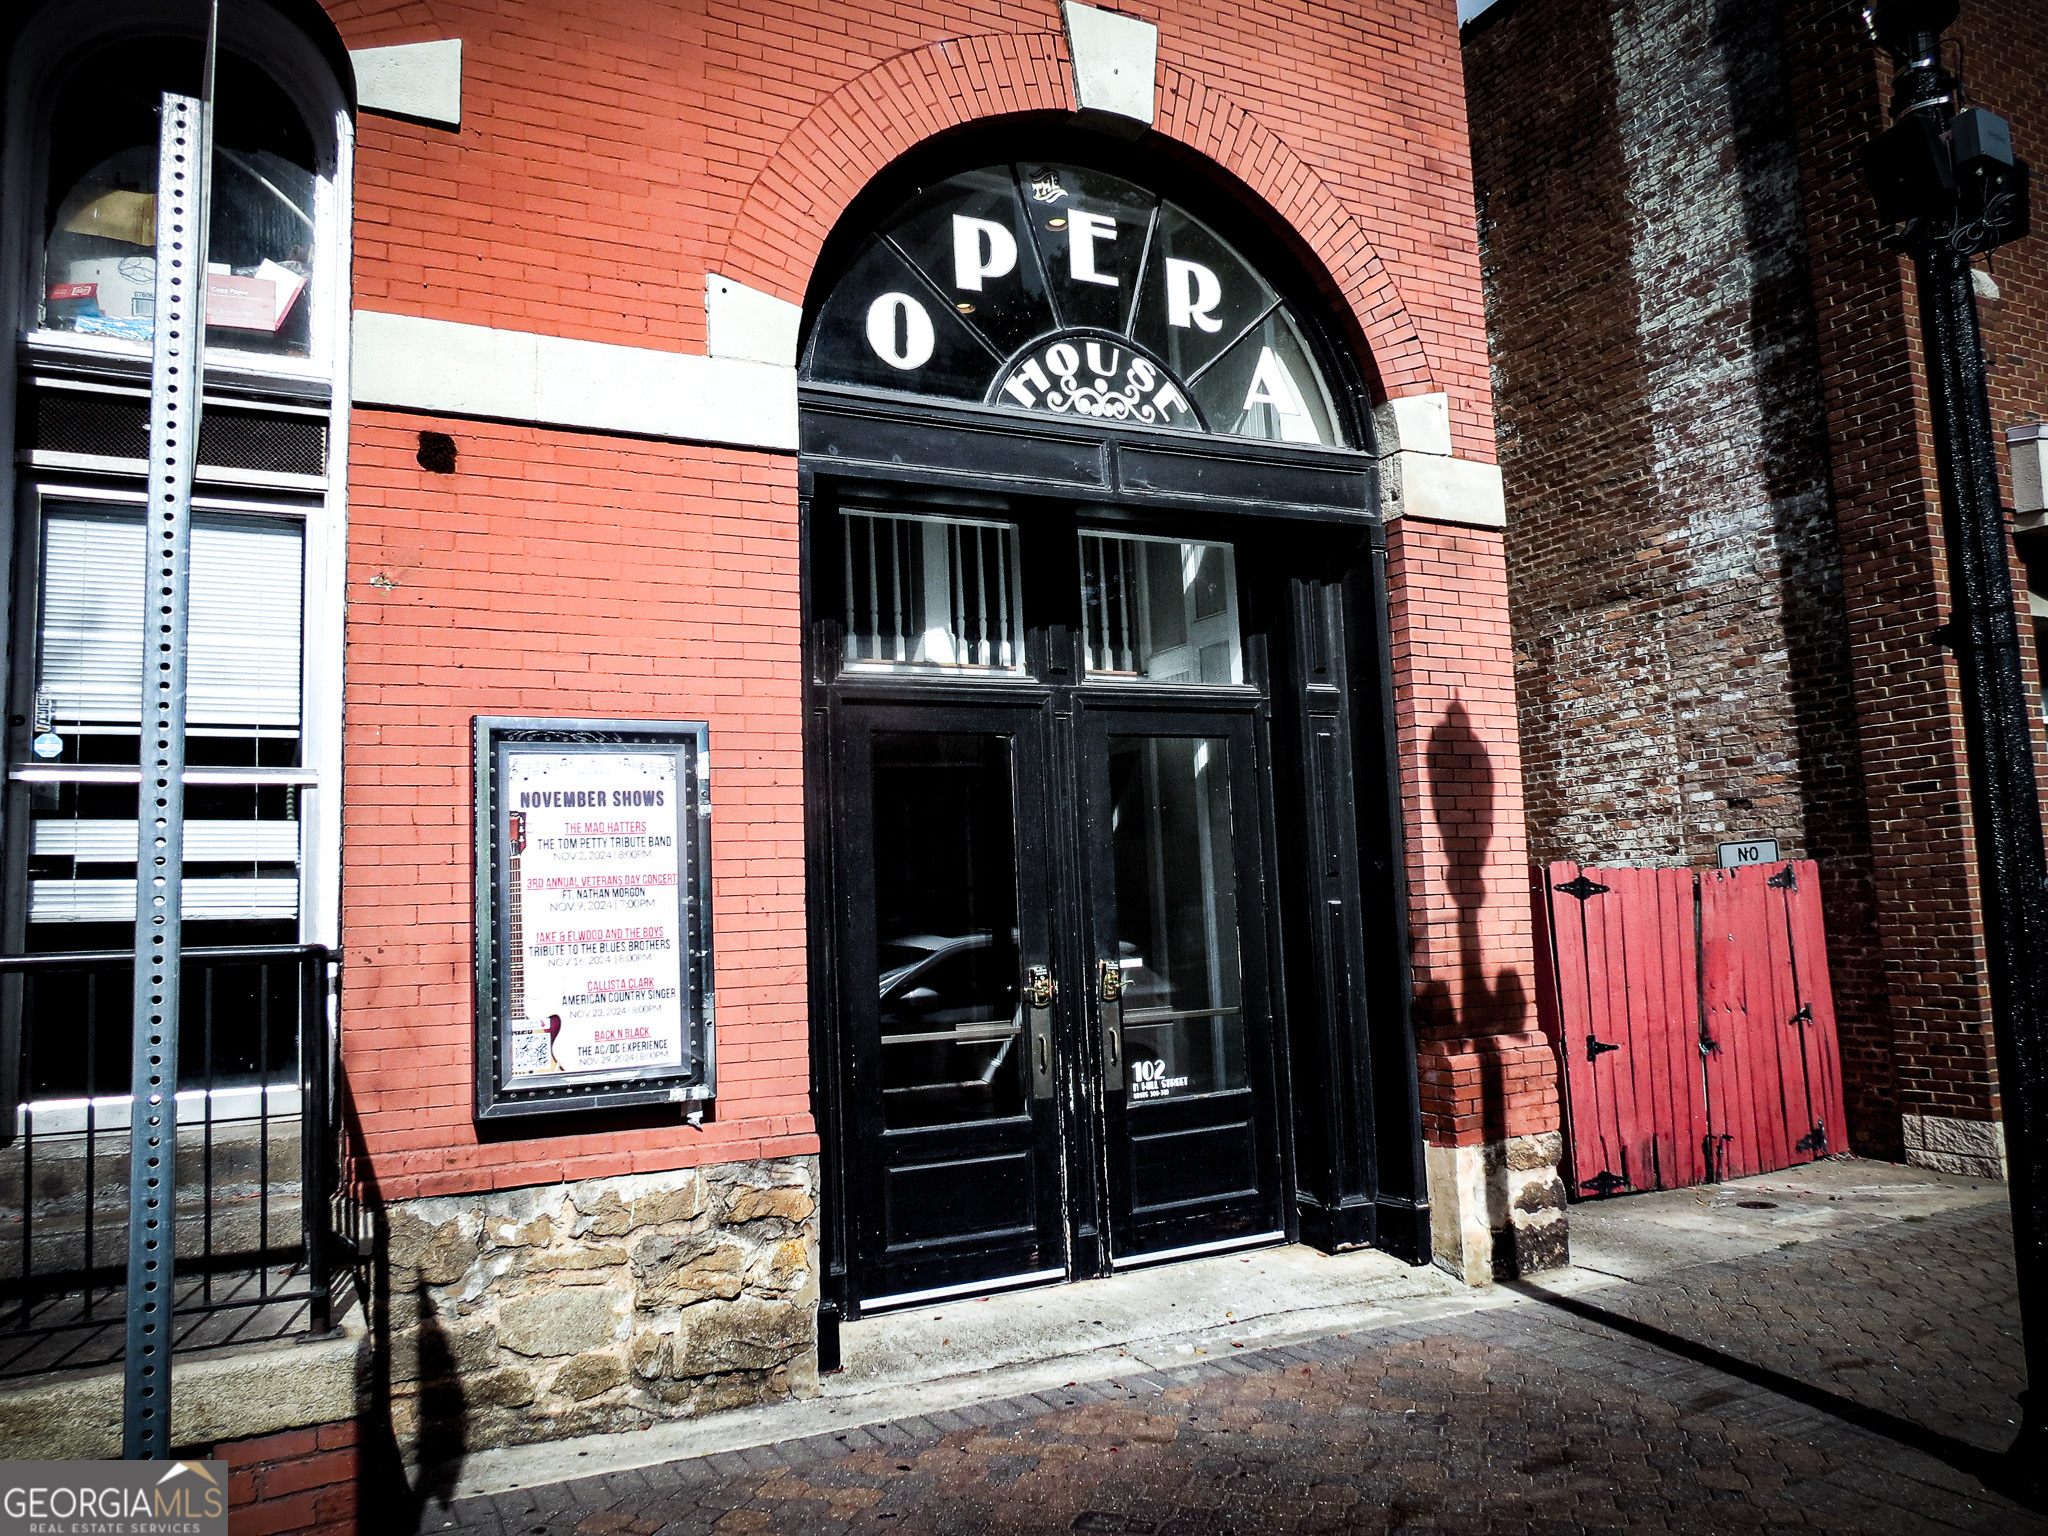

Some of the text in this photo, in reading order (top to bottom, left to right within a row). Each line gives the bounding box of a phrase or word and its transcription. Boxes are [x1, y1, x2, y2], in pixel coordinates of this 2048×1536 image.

[866, 208, 1300, 417] OPERA
[1004, 342, 1188, 422] HOUSE
[520, 790, 665, 808] NOVEMBER SHOWS
[565, 821, 647, 834] THE MAD HATTERS
[538, 836, 672, 850] THE TOM PETTY TRIBUTE BAND
[553, 851, 576, 861] NOV
[589, 850, 612, 860] 2024
[619, 849, 652, 859] 8:00PM
[1737, 846, 1759, 862] NO
[527, 873, 677, 889] 3RD ANNUAL VETERANS DAY CONCERT
[562, 887, 646, 900] FT. NATHAN MORGON
[549, 902, 575, 912] NOV
[588, 900, 613, 911] 2024
[536, 926, 664, 943] JAKE & ELWOOD AND THE BOYS
[528, 939, 671, 957] TRIBUTE TO THE BLUES BROTHERS
[548, 957, 571, 967] NOV
[588, 955, 611, 965] 2024
[587, 977, 655, 992] CALLISTA CLARK
[562, 988, 676, 1006] AMERICAN COUNTRY SINGER
[569, 1009, 591, 1019] NOV
[606, 1007, 627, 1017] 2024
[594, 1026, 650, 1041] BACK N BLACK
[578, 1039, 668, 1057] THE AC/DC EXPERIENCE
[579, 1057, 599, 1067] NOV
[615, 1053, 635, 1063] 2024
[1131, 1059, 1166, 1083] 102
[1160, 1076, 1189, 1089] STREET
